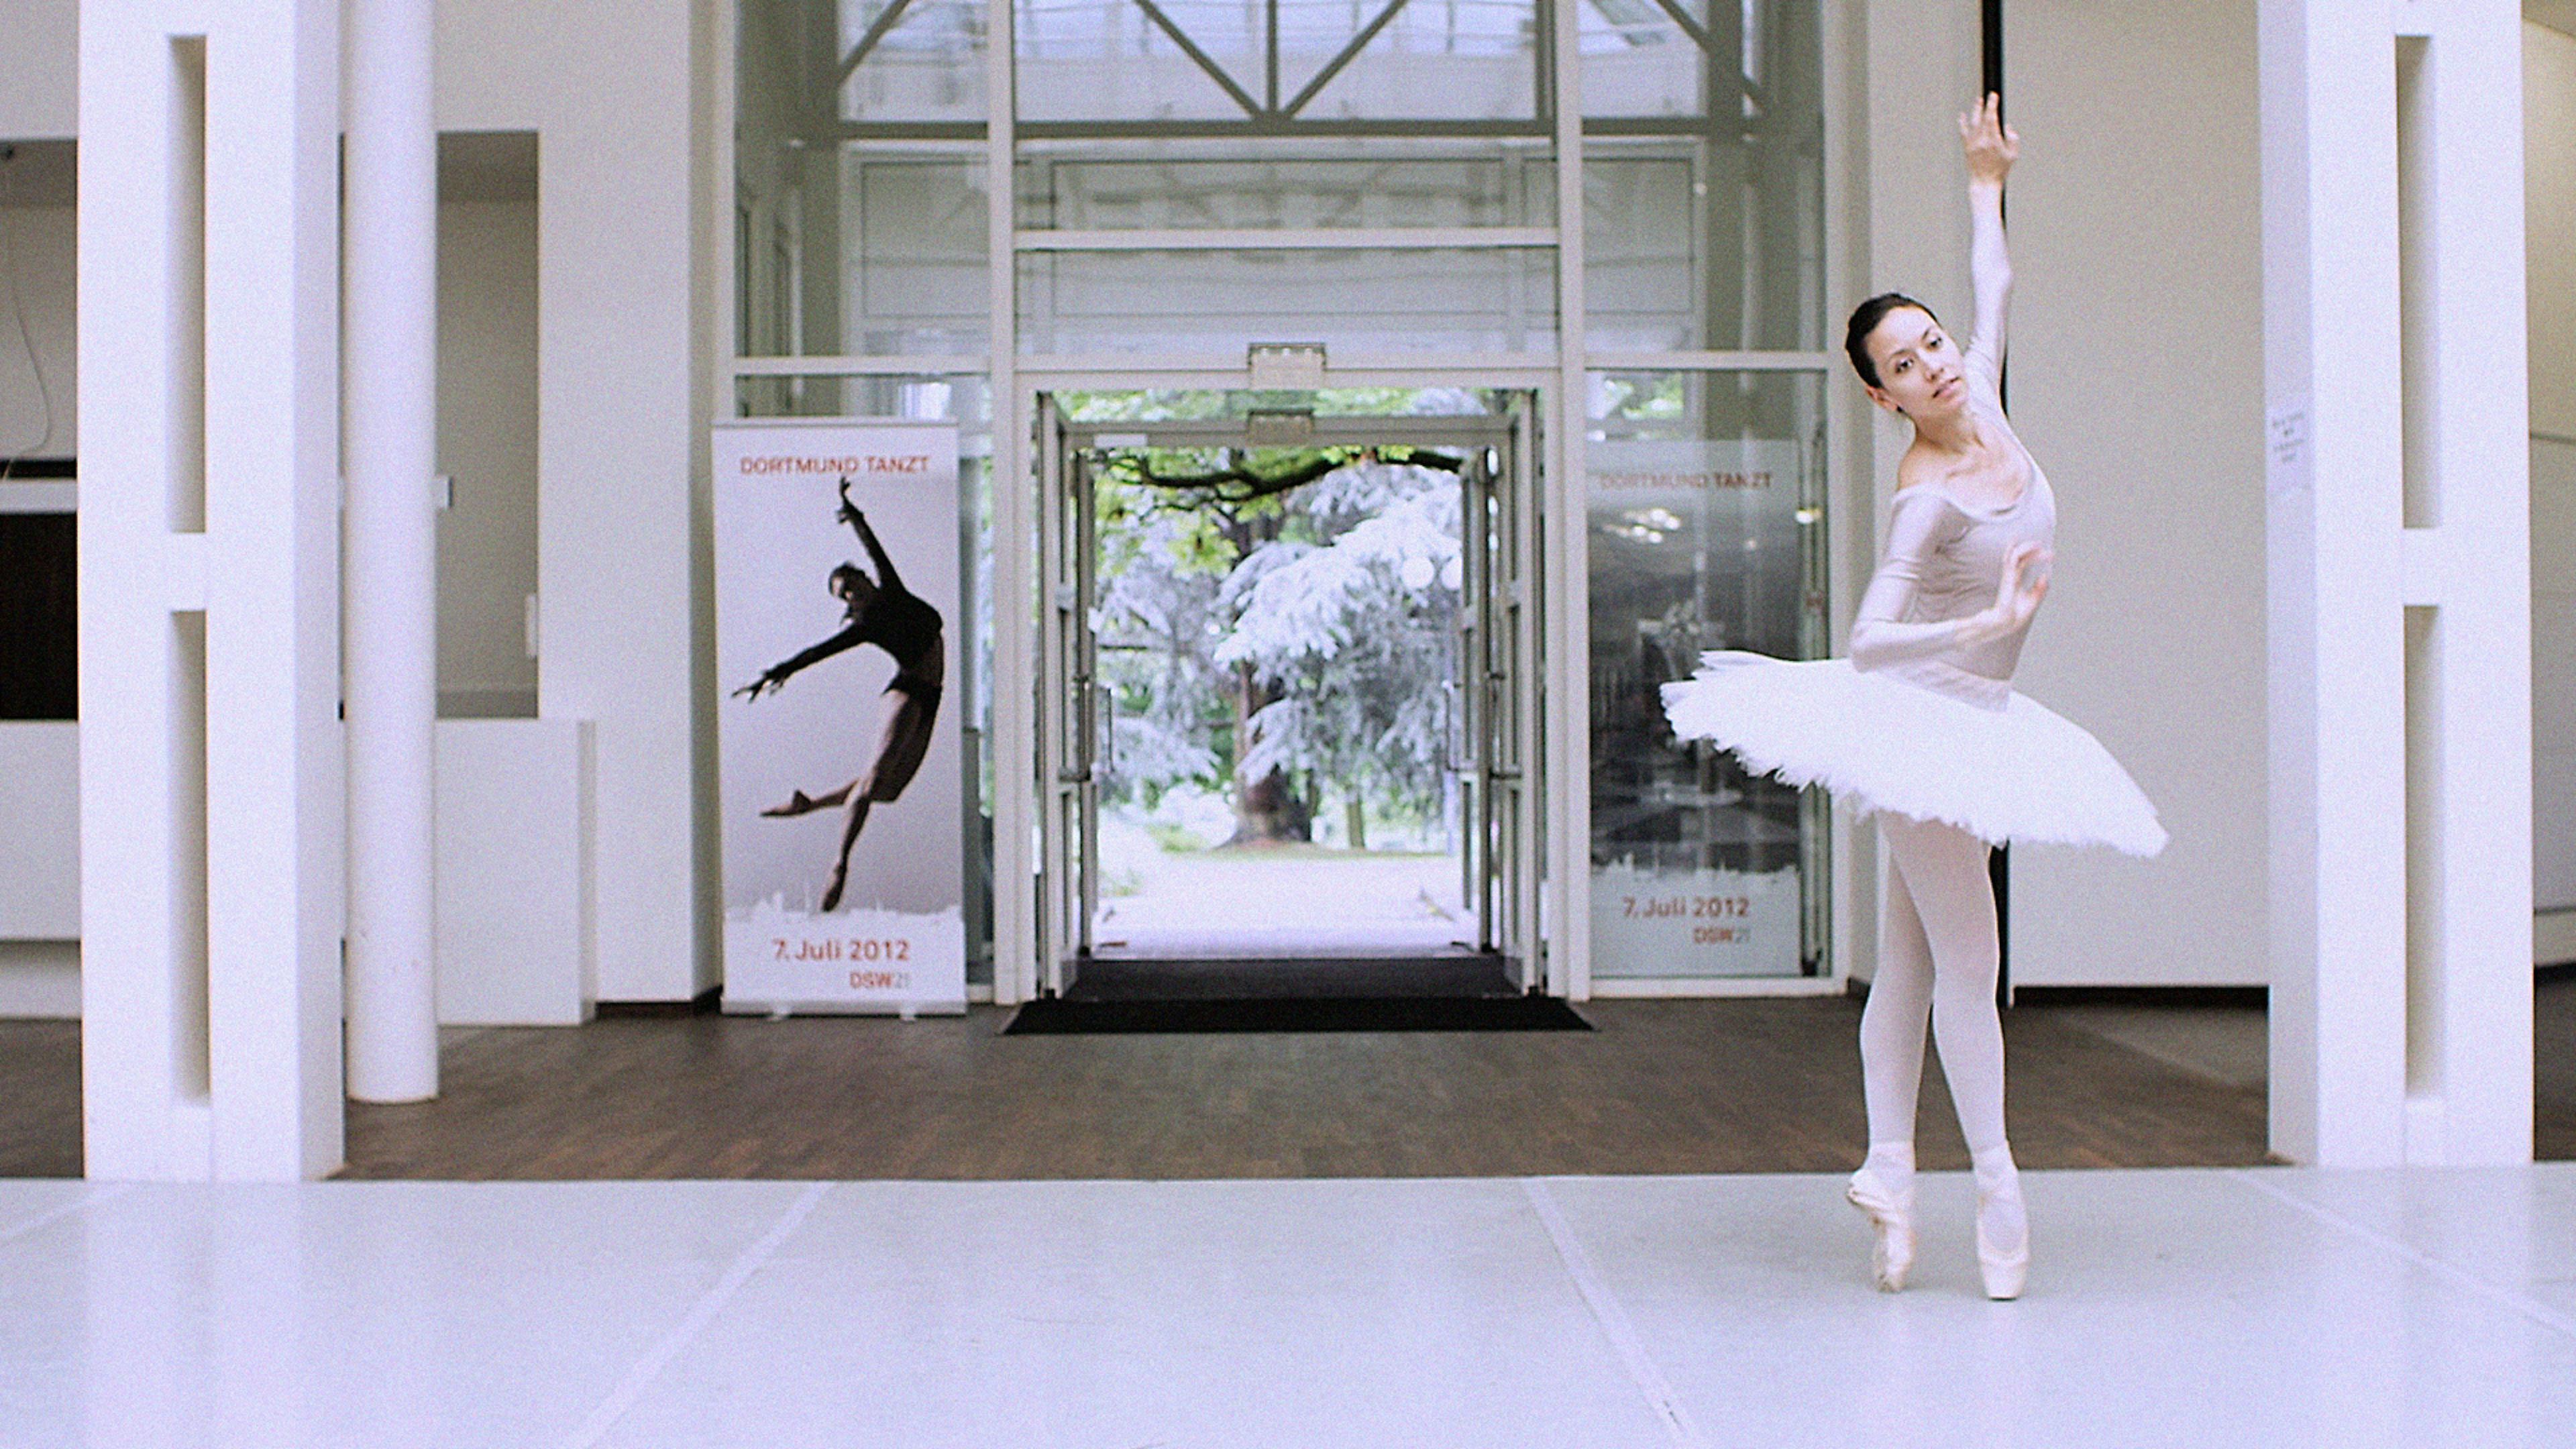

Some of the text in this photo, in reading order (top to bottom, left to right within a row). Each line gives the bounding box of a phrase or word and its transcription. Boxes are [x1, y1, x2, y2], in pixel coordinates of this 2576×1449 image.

[741, 455, 930, 474] DORTMUND TANZT
[1693, 896, 1750, 918] 2012
[849, 938, 911, 961] 2012
